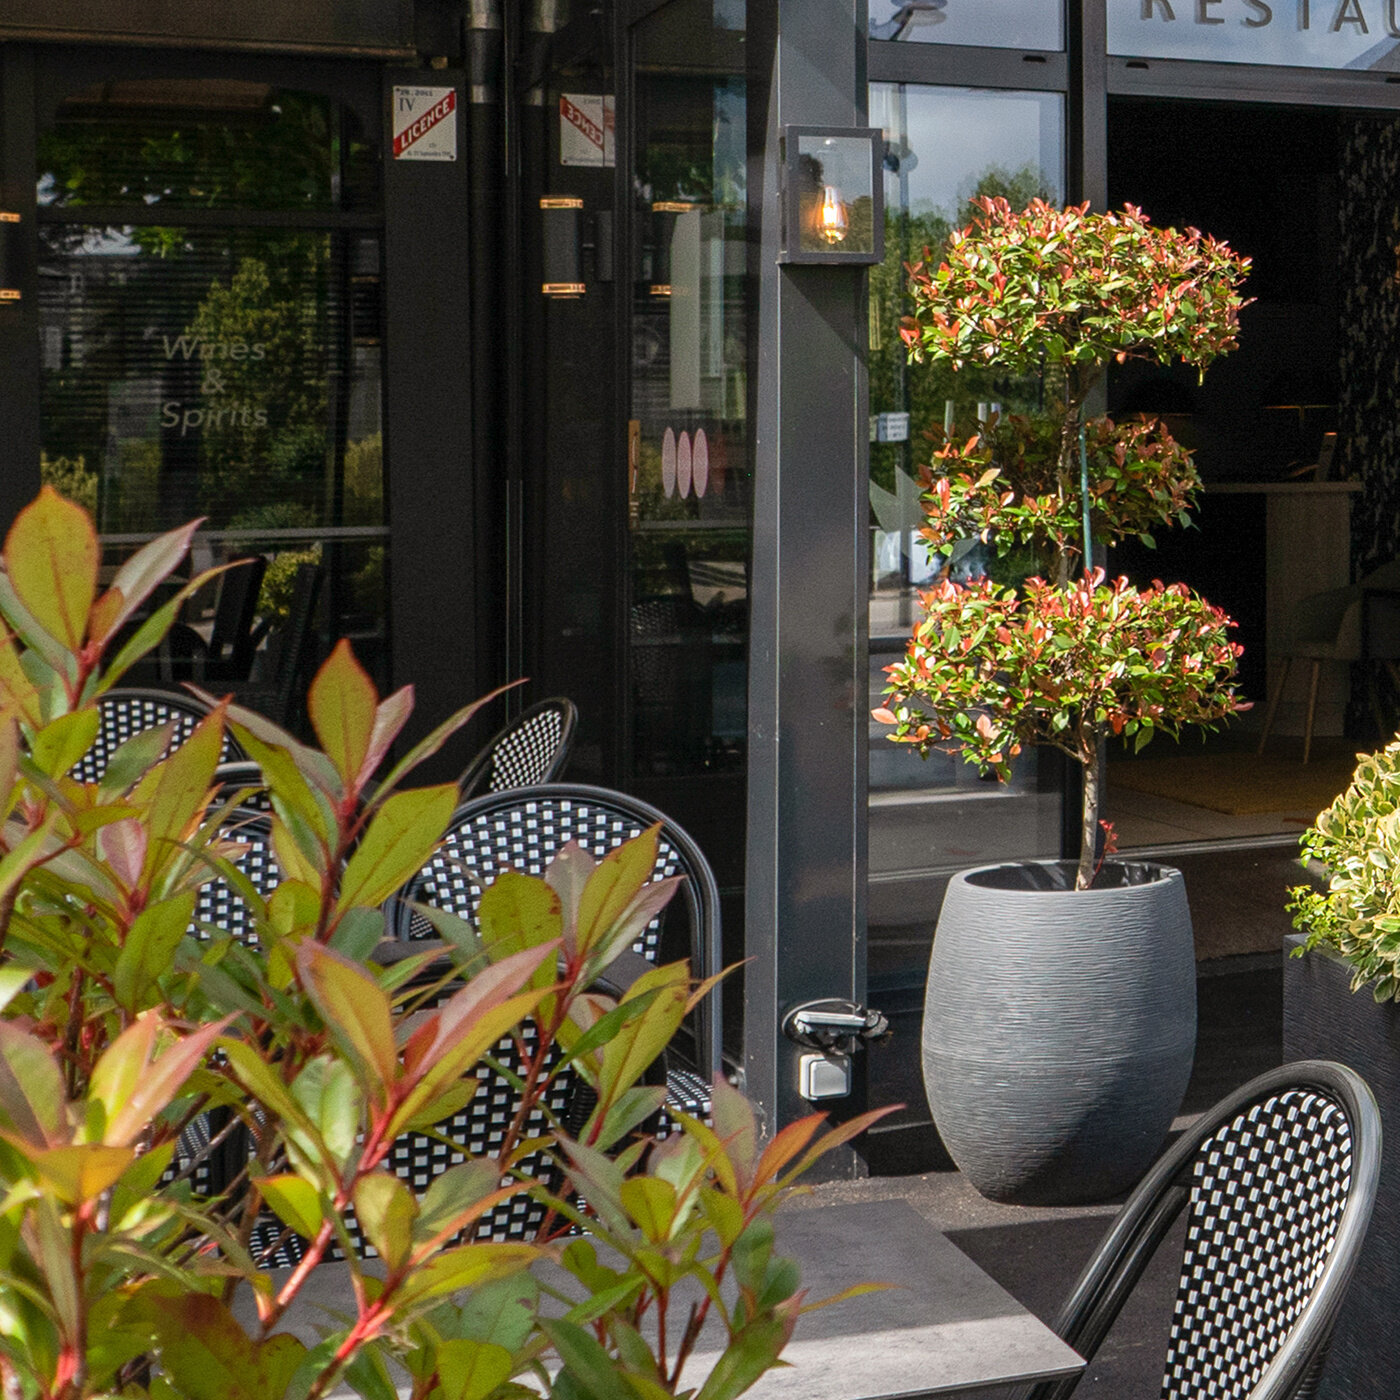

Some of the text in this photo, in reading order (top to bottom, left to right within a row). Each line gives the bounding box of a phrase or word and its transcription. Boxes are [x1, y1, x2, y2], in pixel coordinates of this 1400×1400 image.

[400, 98, 450, 149] LICENCE
[163, 335, 266, 360] Wines
[201, 368, 226, 394] &
[160, 401, 268, 437] Spirits
